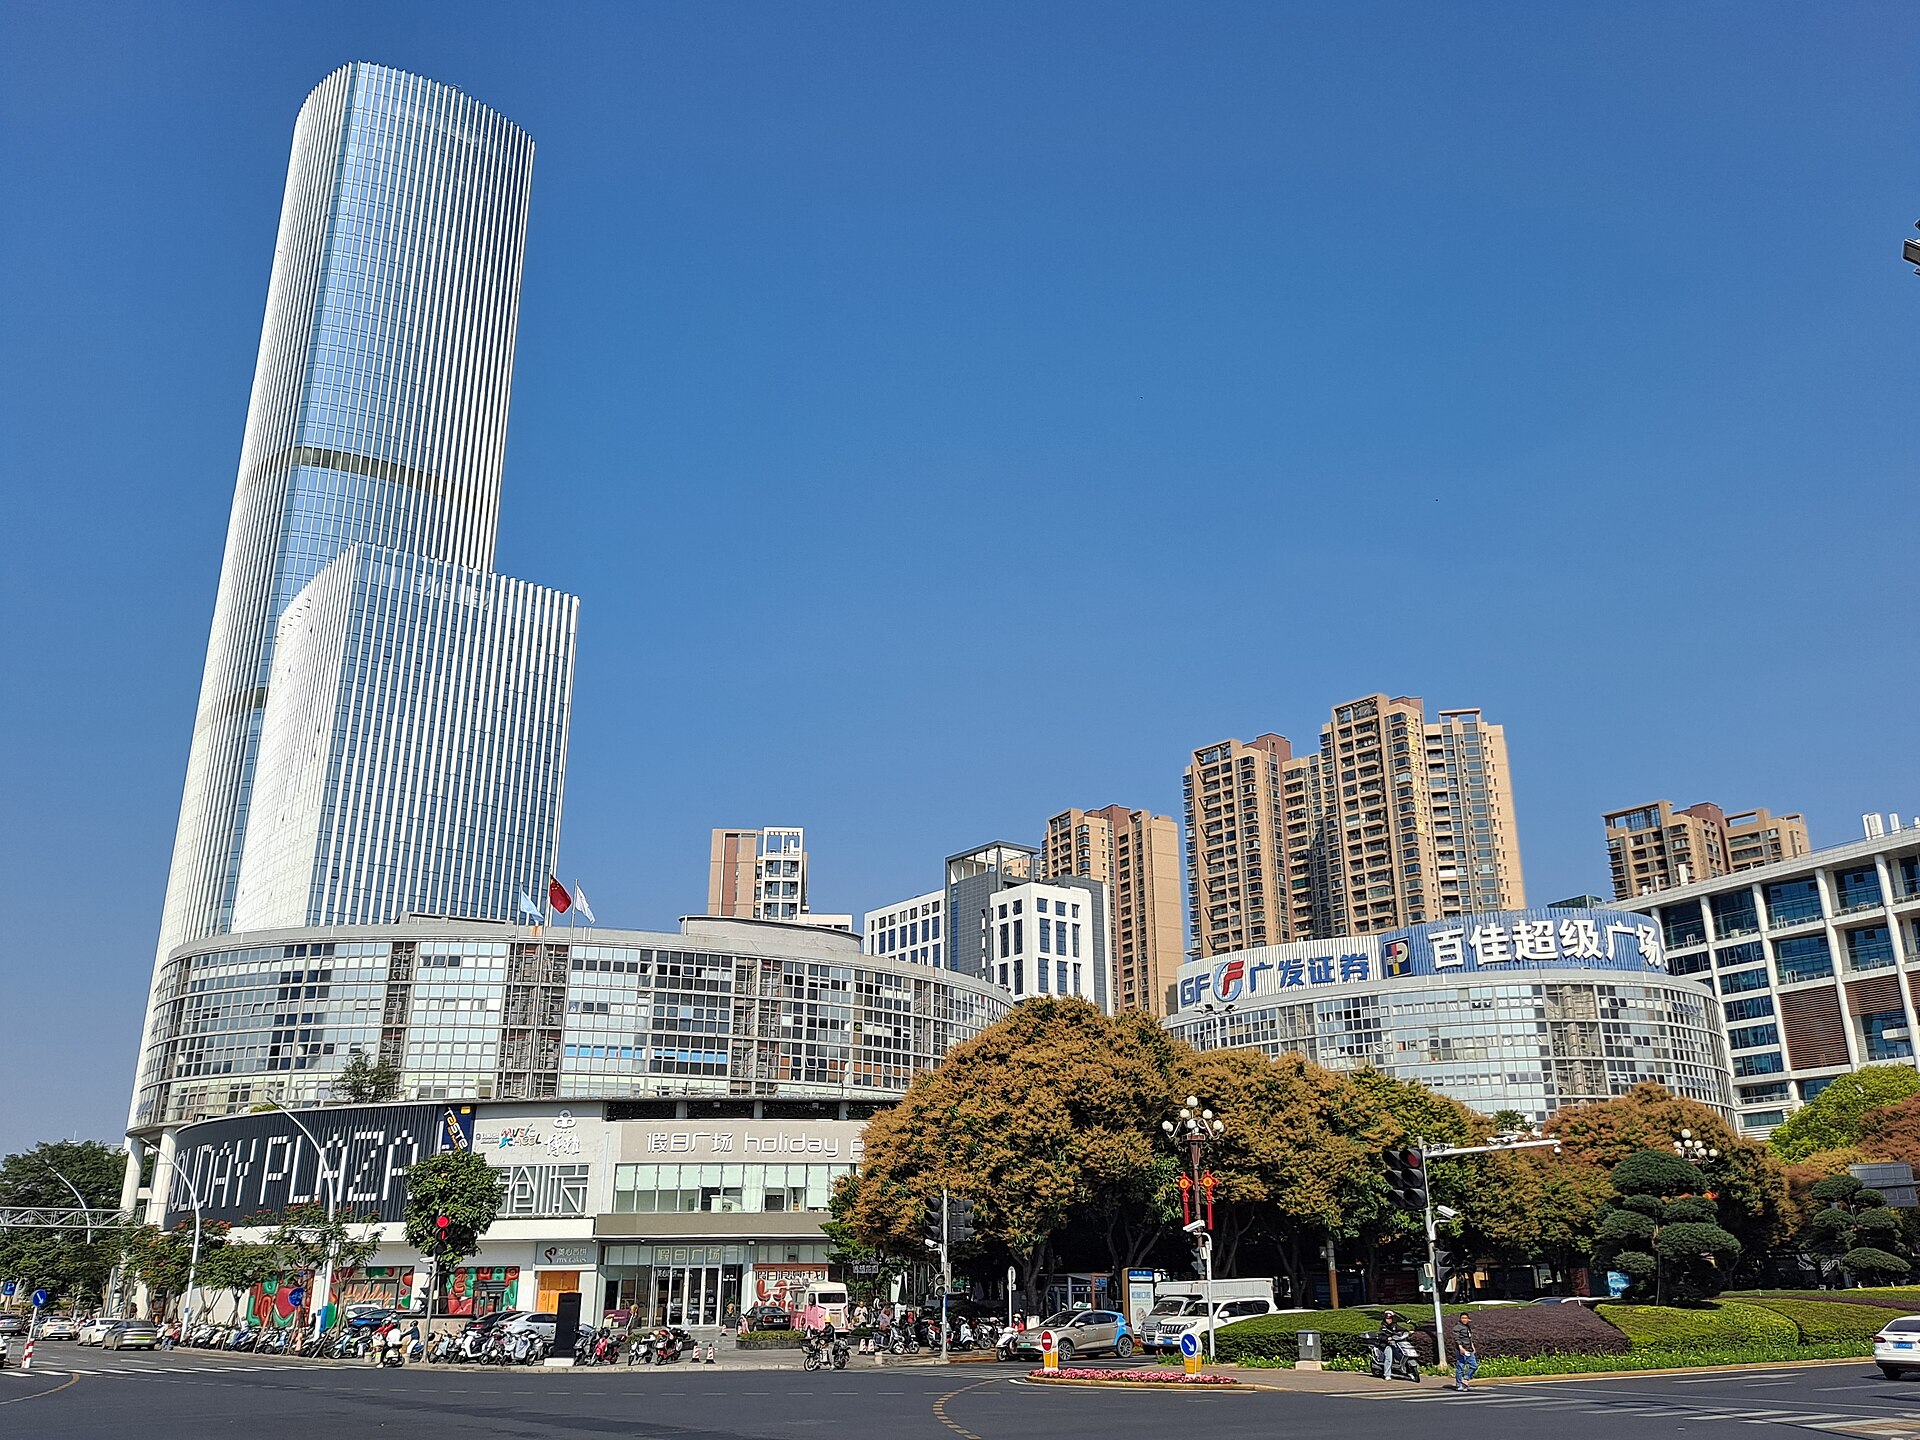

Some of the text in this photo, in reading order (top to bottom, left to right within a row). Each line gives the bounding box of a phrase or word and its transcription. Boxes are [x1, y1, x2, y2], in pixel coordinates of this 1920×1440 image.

[1428, 918, 1668, 970] 百佳超级广场
[1180, 972, 1211, 1007] GF
[1249, 952, 1369, 992] 广发证券
[646, 1132, 734, 1154] 假日广场
[744, 1132, 839, 1158] holiday
[168, 1129, 418, 1214] OLIDAY PLAZA
[657, 1248, 720, 1261] 假日广场
